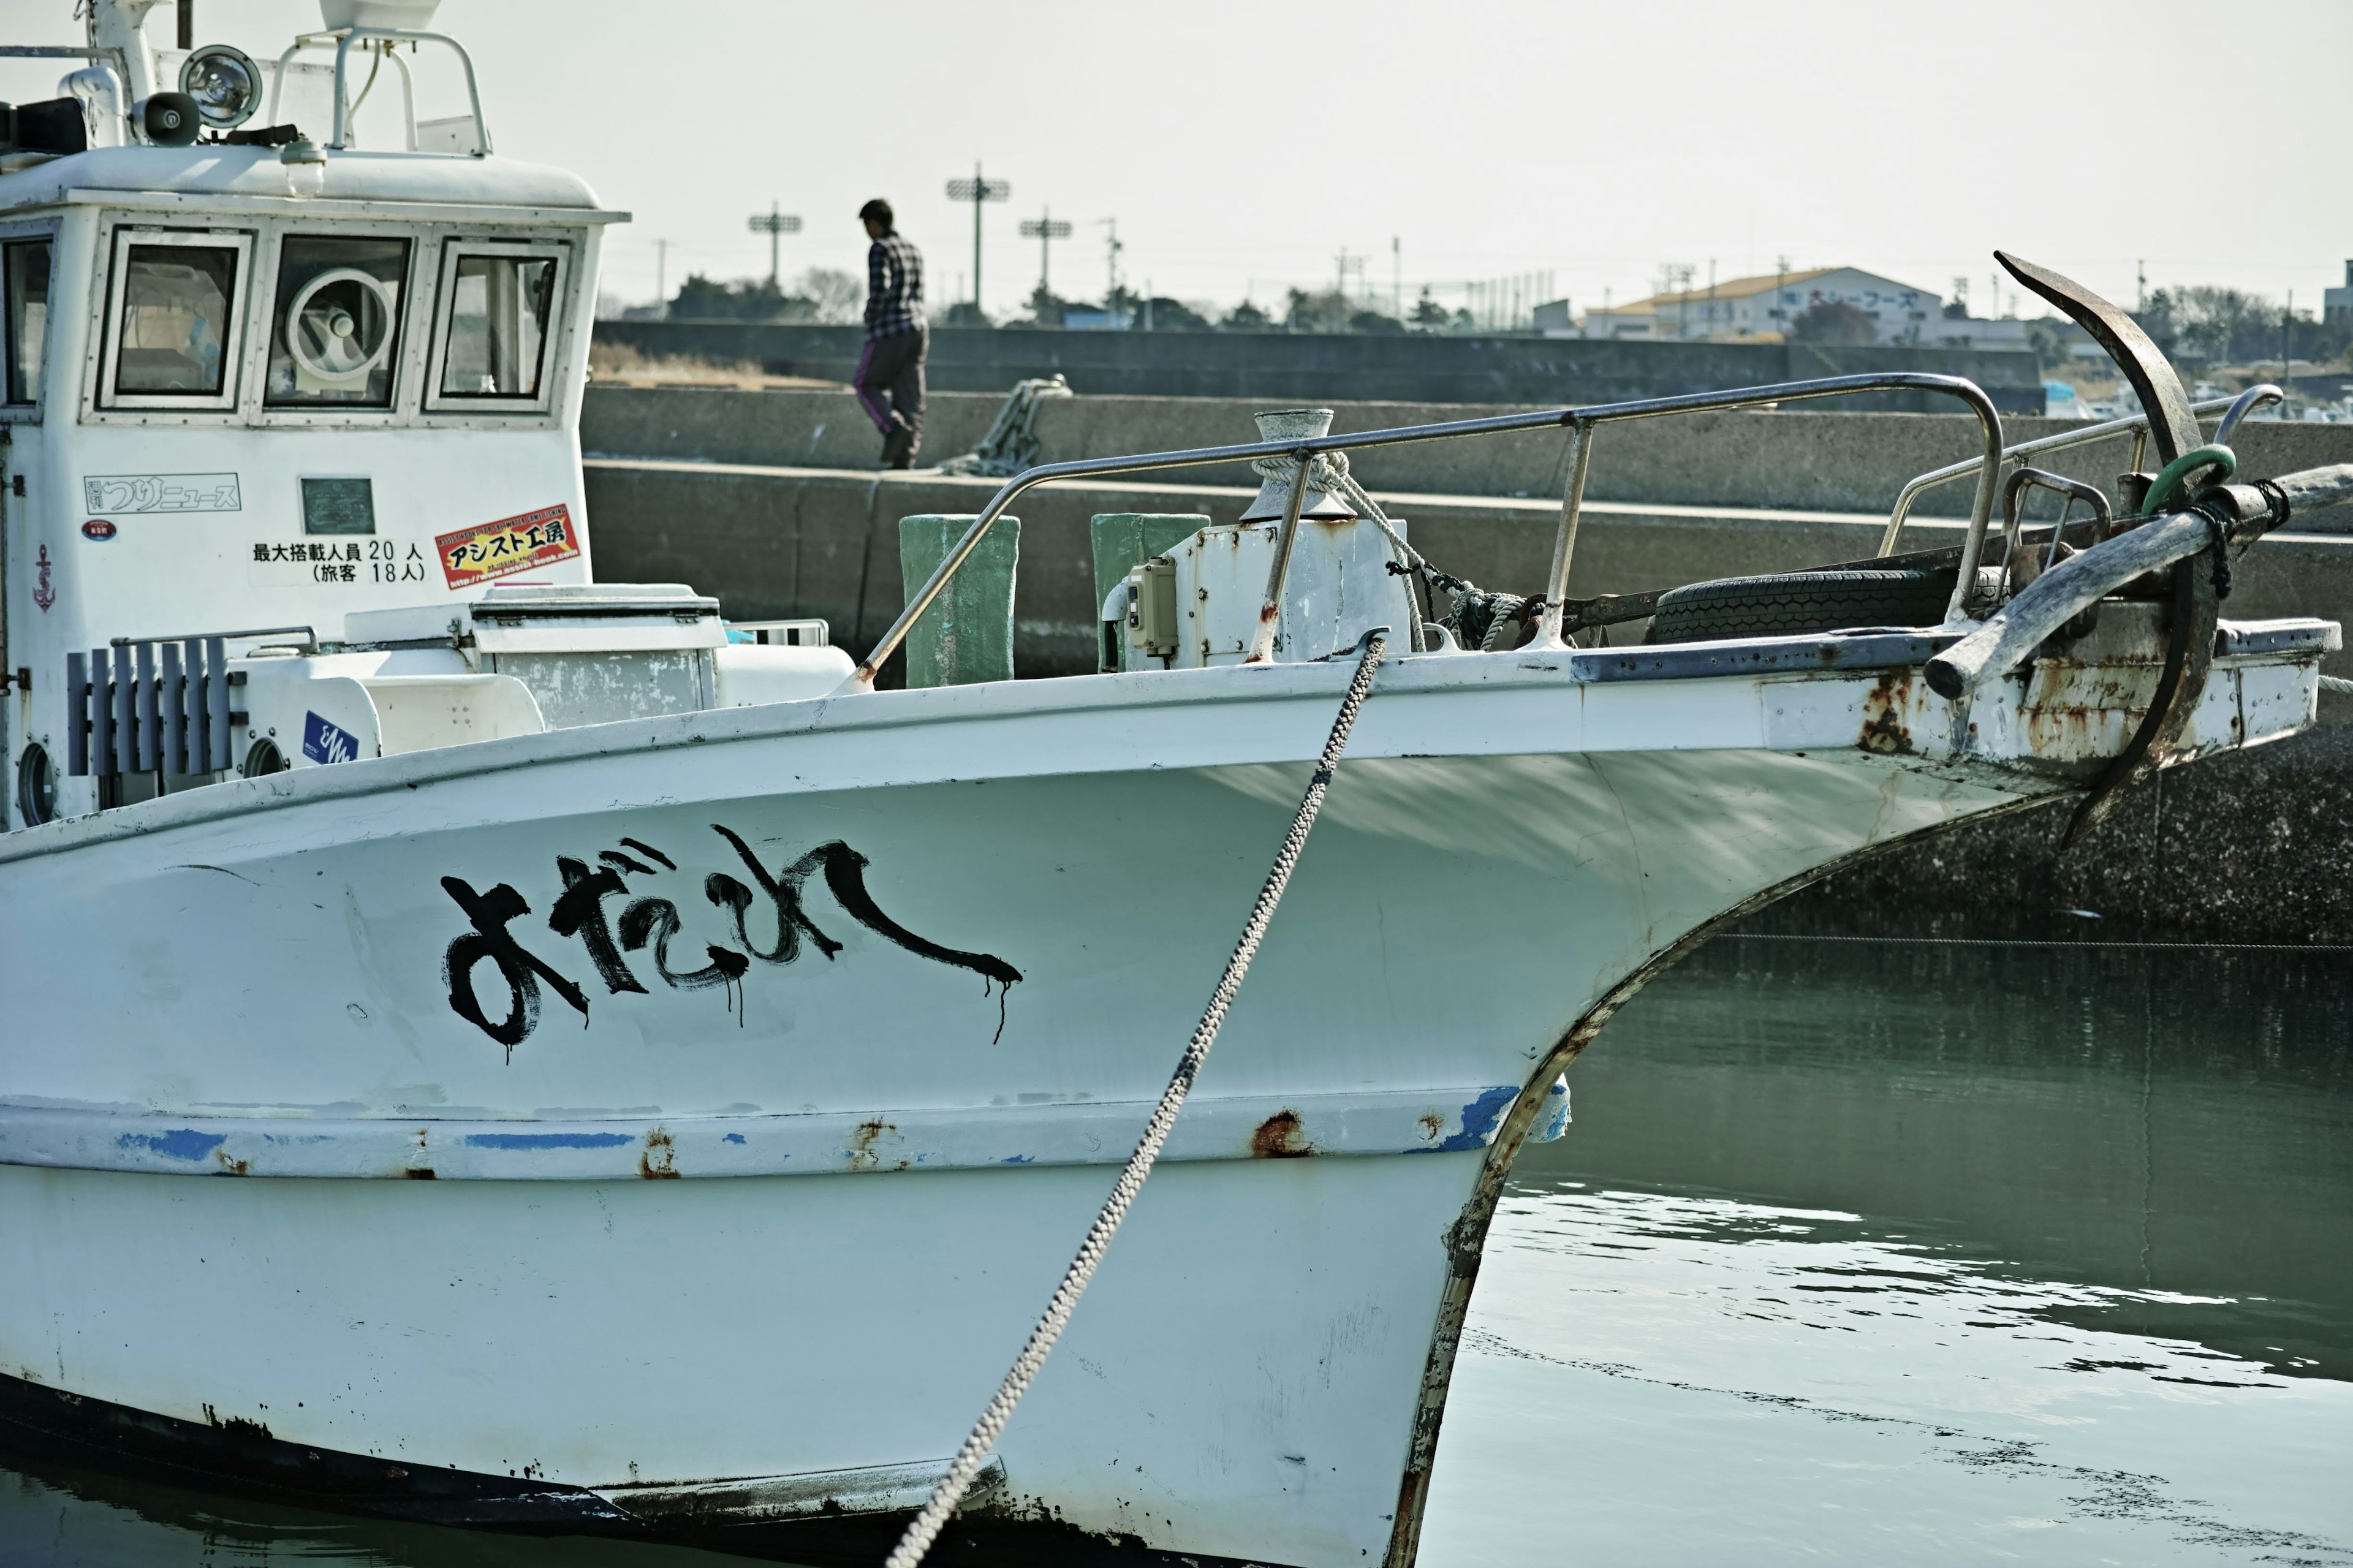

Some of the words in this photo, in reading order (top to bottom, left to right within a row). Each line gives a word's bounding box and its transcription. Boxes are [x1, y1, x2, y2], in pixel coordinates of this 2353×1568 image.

[102, 477, 238, 512] つりニュース
[439, 535, 460, 546] ASSIST
[460, 529, 480, 540] HOOKS
[493, 517, 526, 532] SALTWATER
[544, 507, 566, 520] FISHING
[450, 520, 565, 569] アシスト工房
